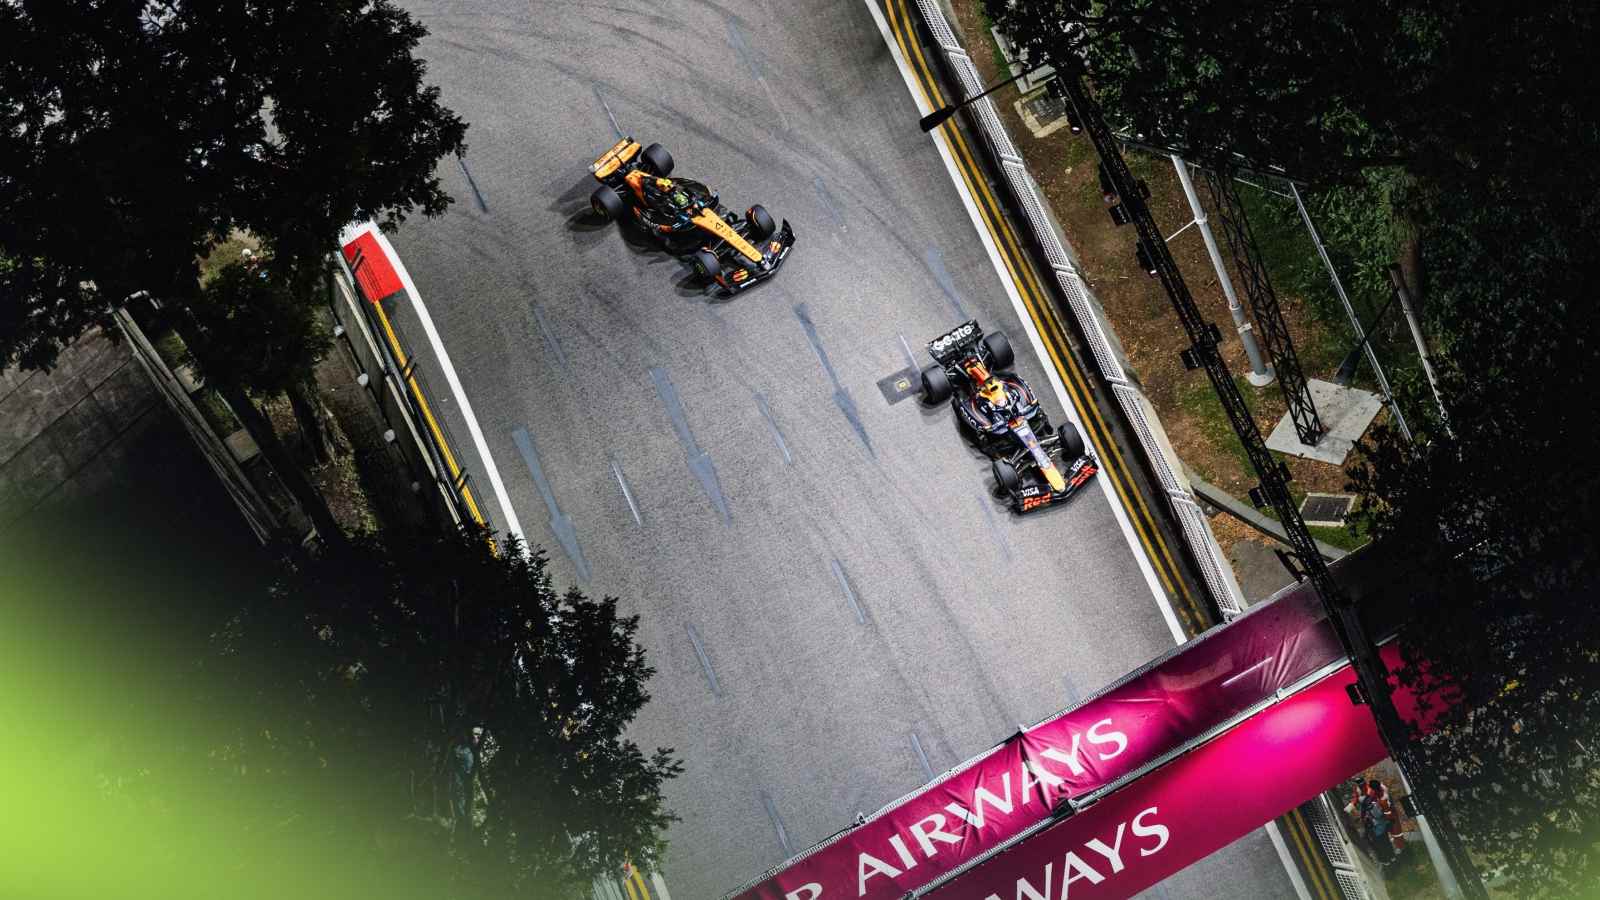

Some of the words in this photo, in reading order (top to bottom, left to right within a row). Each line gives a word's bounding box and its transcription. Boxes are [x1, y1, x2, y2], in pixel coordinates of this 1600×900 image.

[1020, 486, 1040, 498] VISA
[1023, 492, 1052, 511] Red
[856, 717, 1129, 897] AIRWAYS
